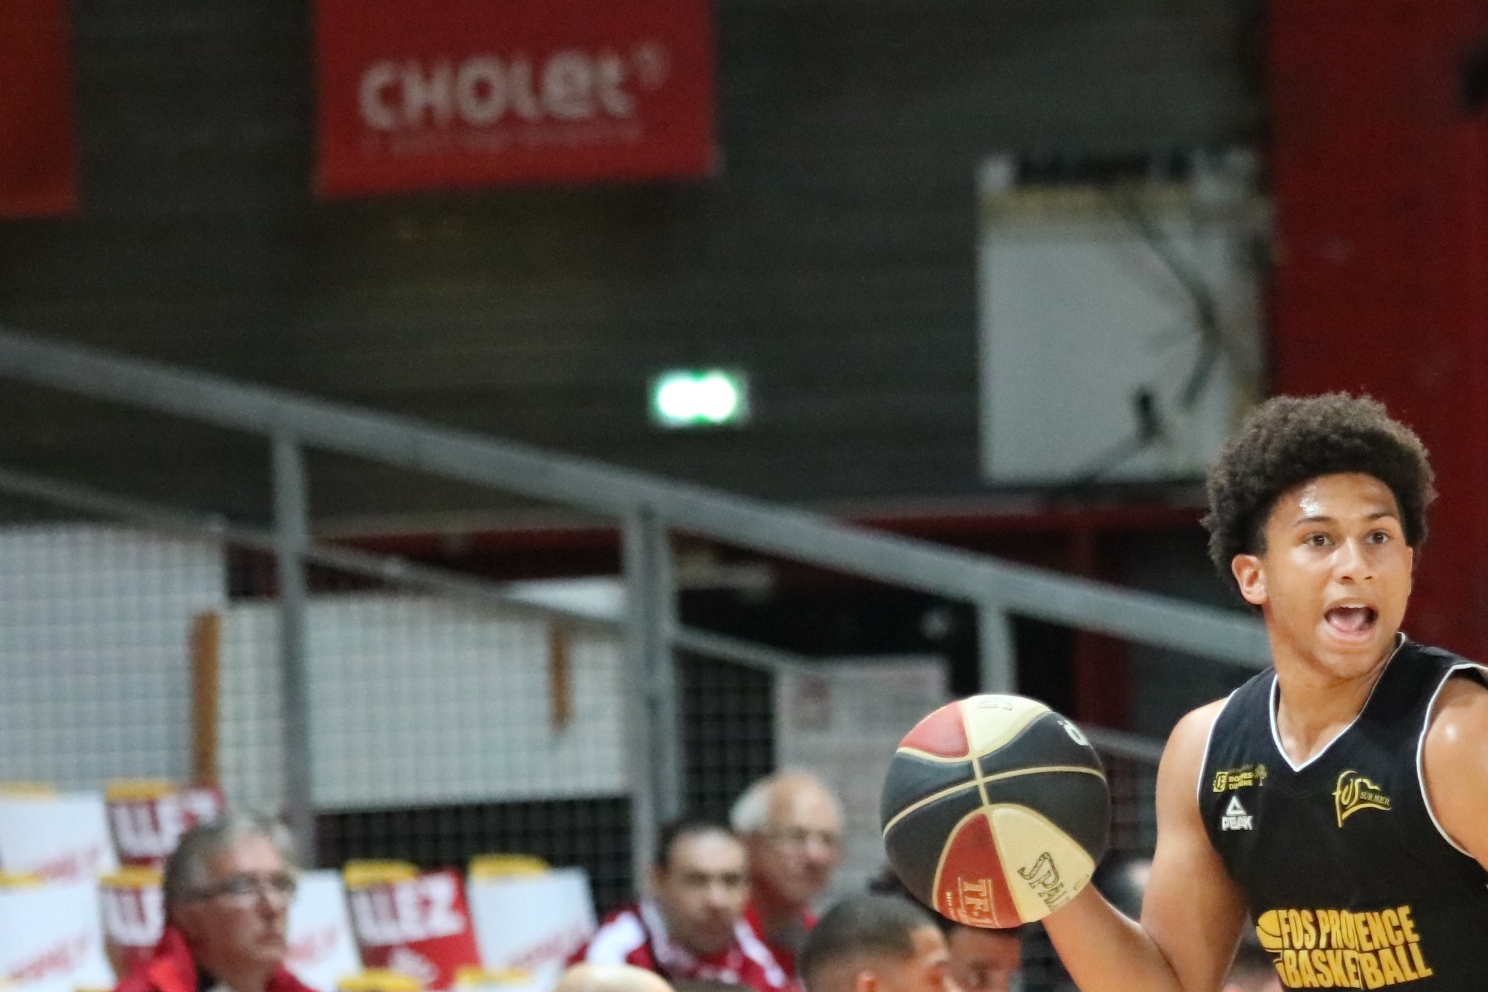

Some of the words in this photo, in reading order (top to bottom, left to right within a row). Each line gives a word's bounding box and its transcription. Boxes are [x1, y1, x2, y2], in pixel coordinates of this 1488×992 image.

[1222, 815, 1253, 831] PEAK
[1278, 908, 1317, 950] FOS
[1316, 905, 1421, 952] PROENCE
[1283, 942, 1434, 990] BASKEBALL
